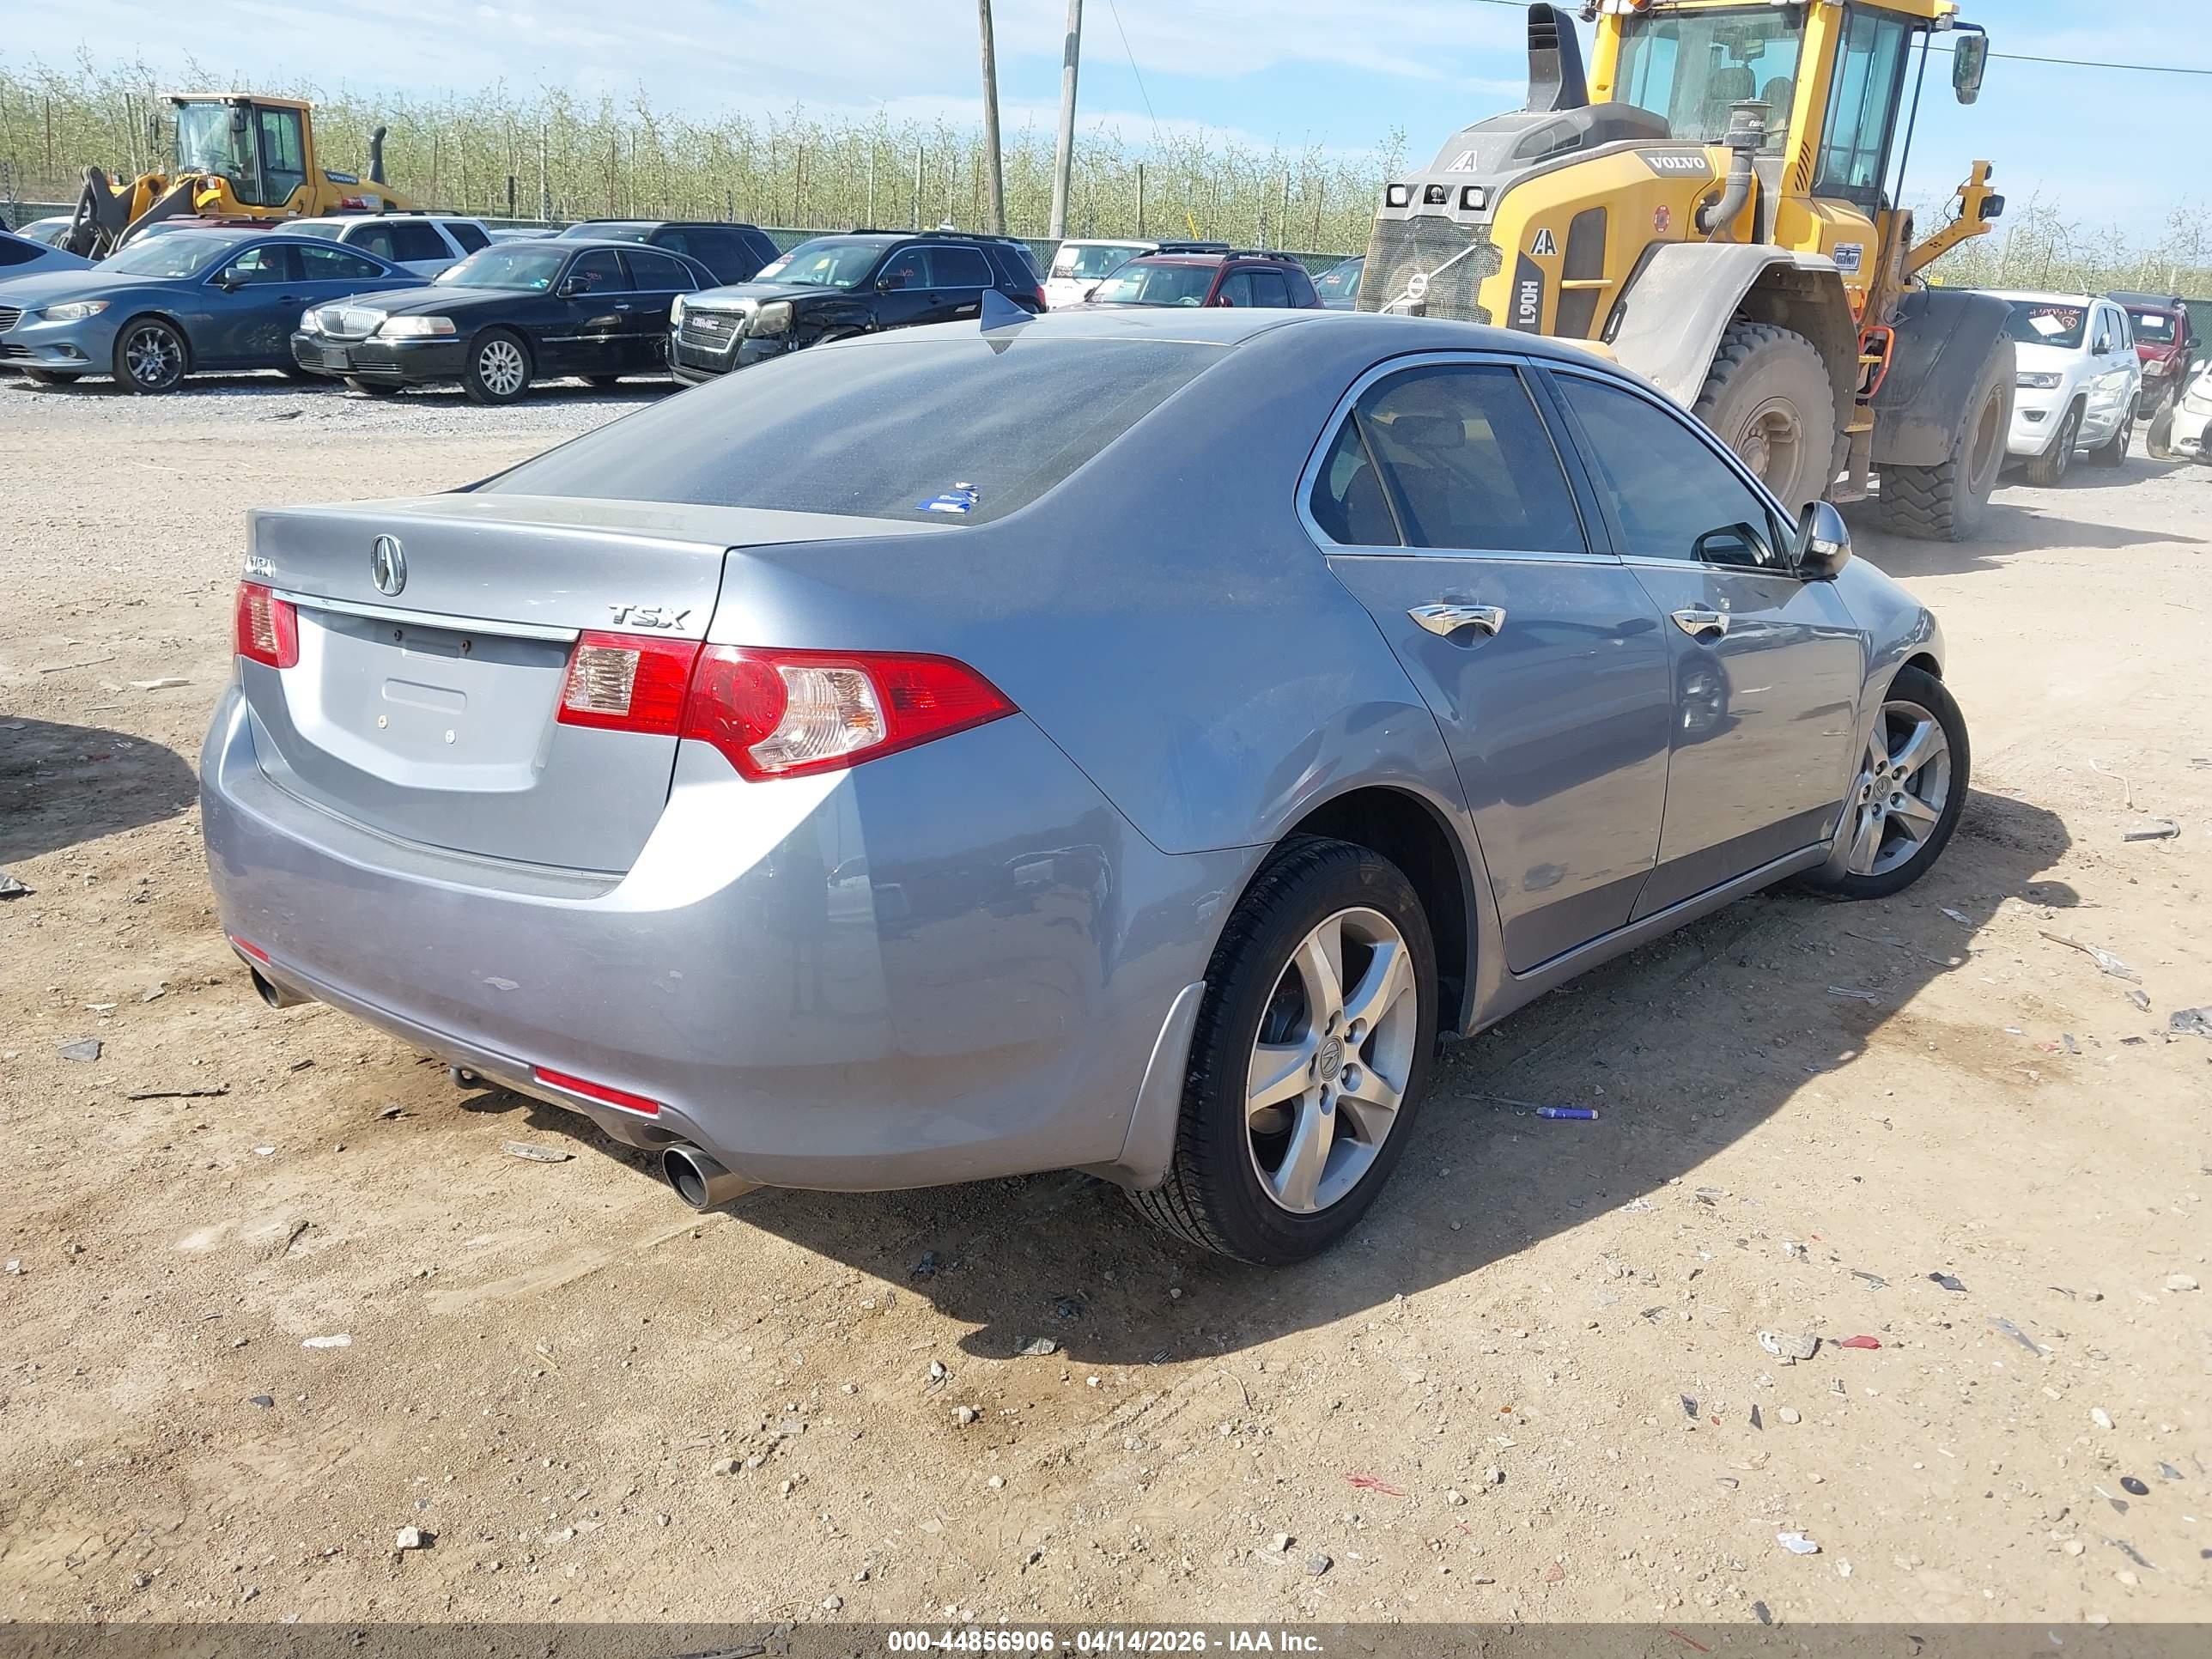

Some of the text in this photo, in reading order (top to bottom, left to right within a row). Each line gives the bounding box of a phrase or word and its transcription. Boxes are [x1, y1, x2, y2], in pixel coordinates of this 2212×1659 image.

[1647, 156, 1705, 169] VOLVO
[327, 173, 358, 183] VOLVO
[1518, 281, 1539, 324] L90H
[691, 317, 720, 331] GMC
[607, 604, 692, 631] TSX
